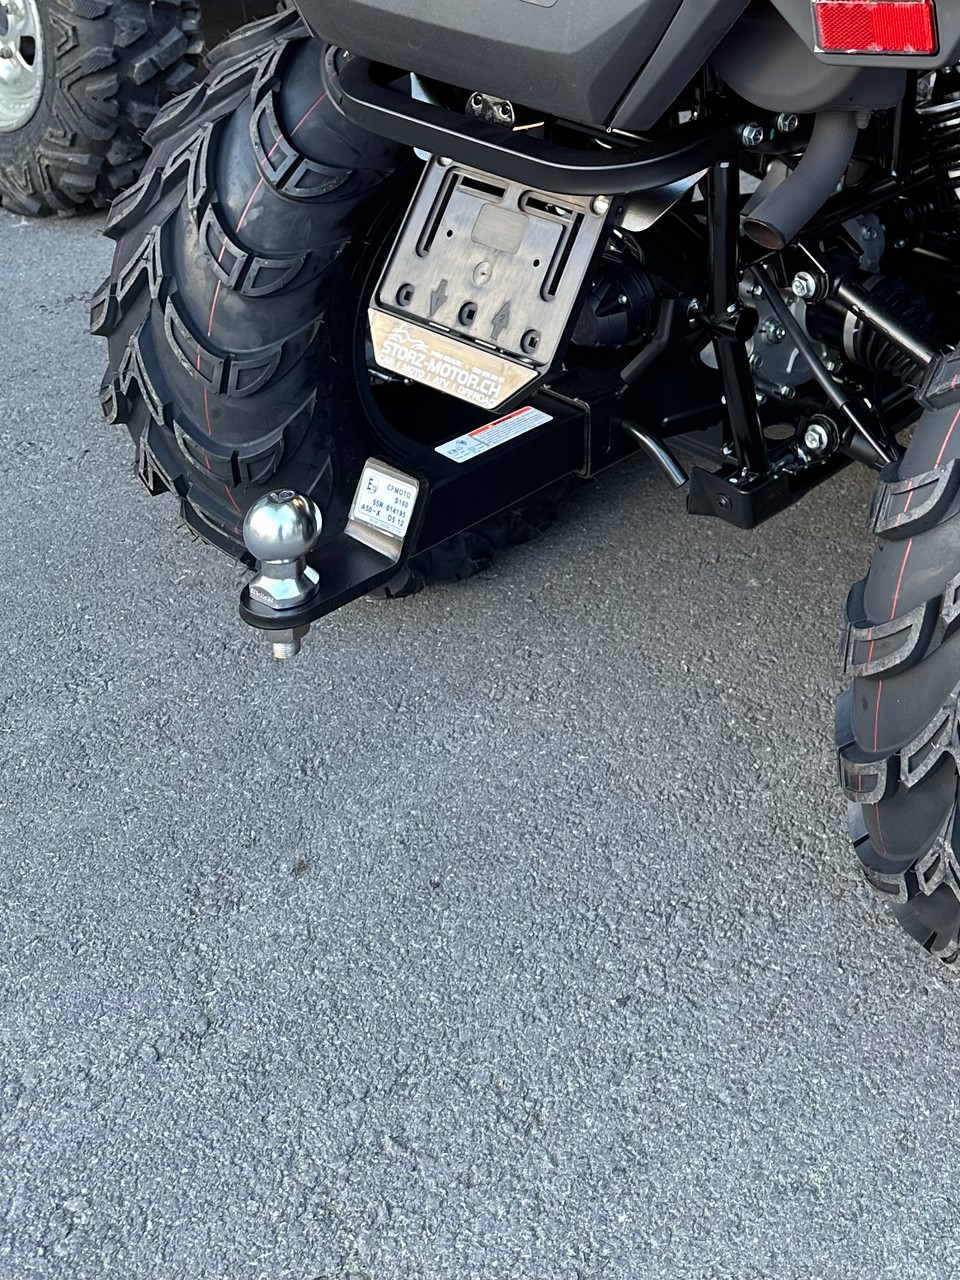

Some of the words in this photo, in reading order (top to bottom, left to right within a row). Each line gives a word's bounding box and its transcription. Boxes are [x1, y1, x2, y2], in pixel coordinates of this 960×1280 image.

[381, 341, 502, 399] STORZ-MOTOR.CH
[402, 363, 425, 378] MOTO
[432, 377, 451, 389] ATV
[458, 385, 496, 406] OFFROAD
[386, 484, 412, 499] CFMOTO
